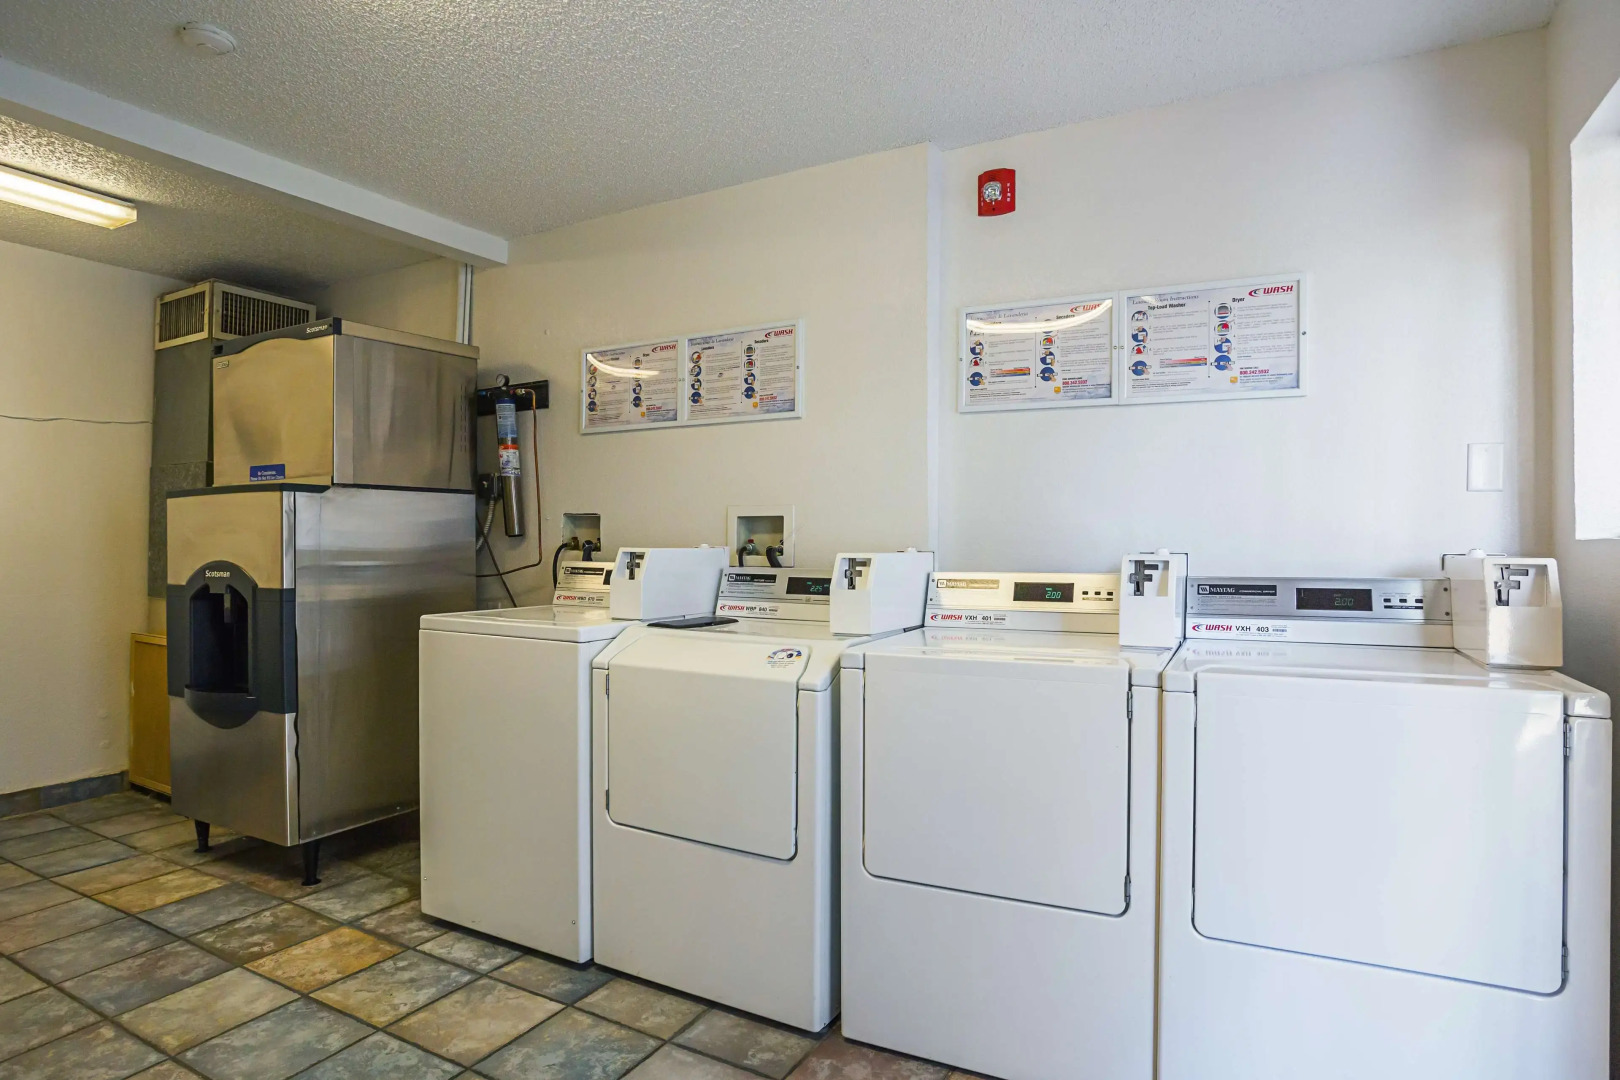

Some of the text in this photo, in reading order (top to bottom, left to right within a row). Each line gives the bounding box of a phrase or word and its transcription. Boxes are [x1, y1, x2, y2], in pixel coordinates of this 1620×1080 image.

[1262, 285, 1294, 295] WASH
[773, 329, 794, 337] WASH
[205, 569, 231, 578] Scotsman
